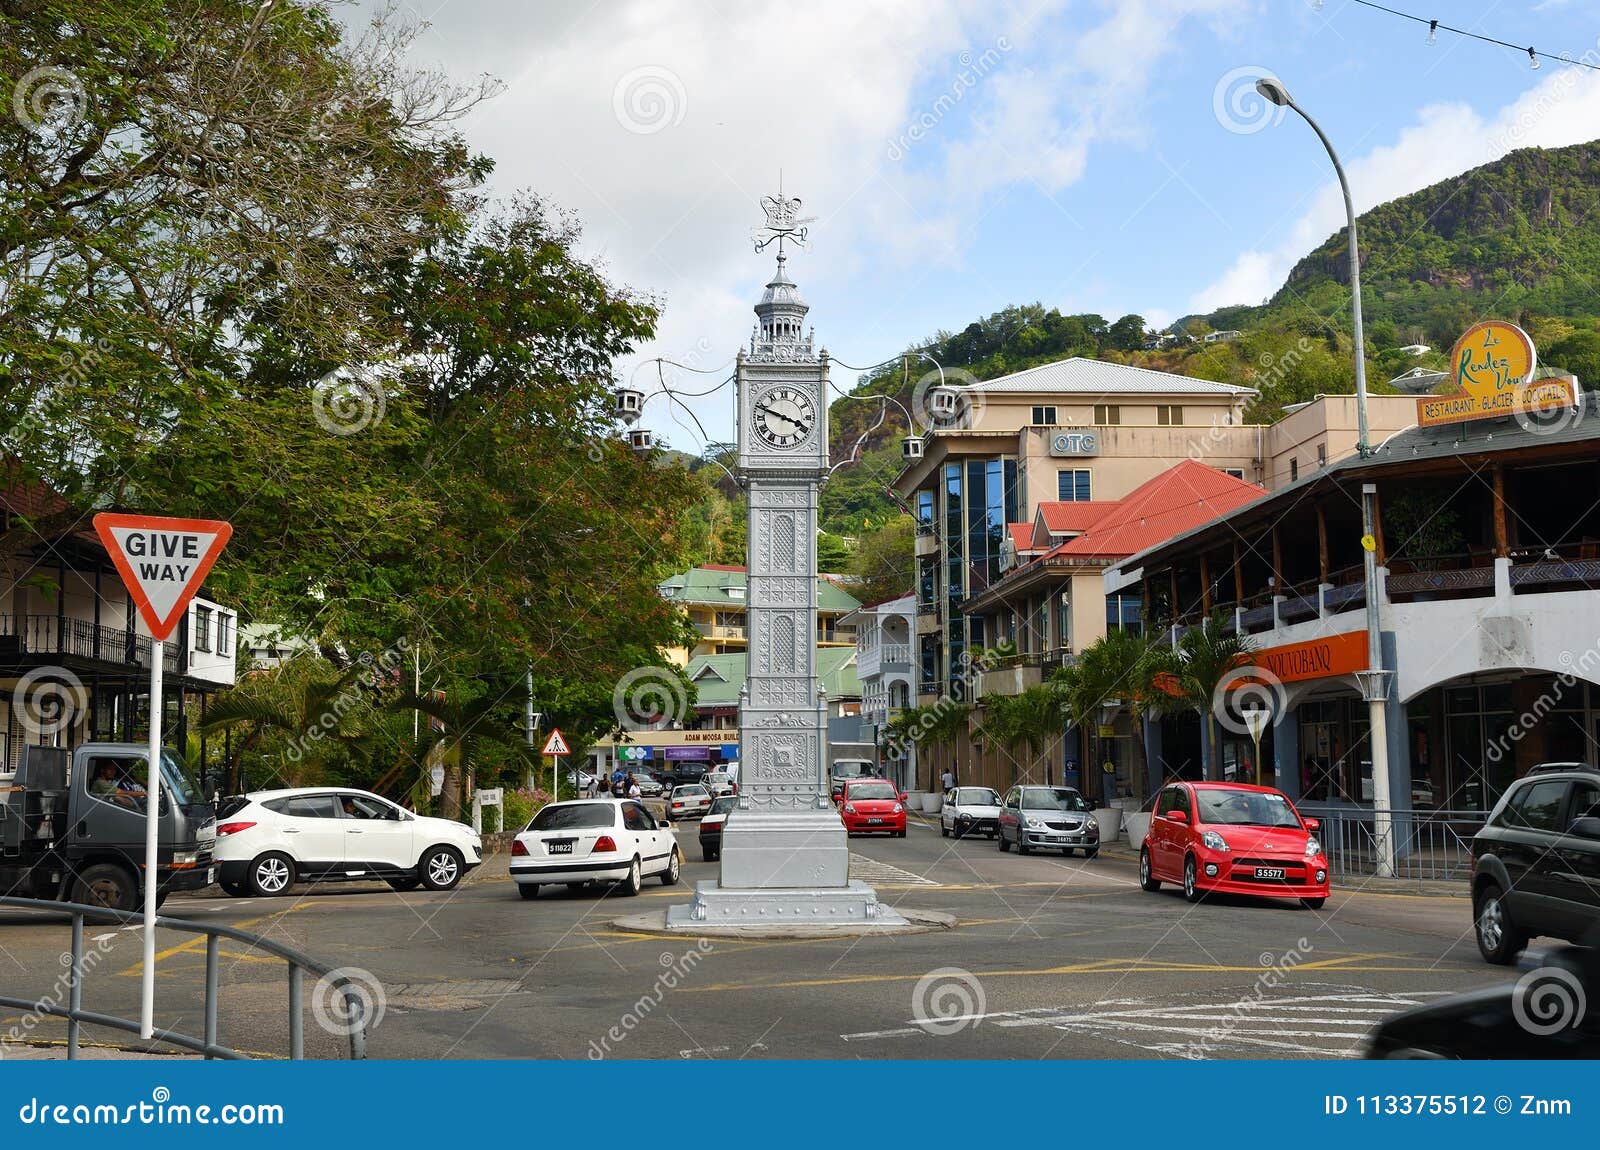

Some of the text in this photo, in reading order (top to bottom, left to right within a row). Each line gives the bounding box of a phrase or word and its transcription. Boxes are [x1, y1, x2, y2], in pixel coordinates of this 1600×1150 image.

[1457, 348, 1511, 385] Rendez
[1425, 398, 1476, 418] RESTAURANT
[1482, 392, 1514, 410] GLACIER
[1522, 385, 1567, 404] COCKTAILS
[1054, 433, 1096, 453] OTC
[125, 532, 199, 559] GIVE
[139, 563, 190, 582] WAY
[1266, 644, 1331, 678] NOUVOBANQ
[685, 733, 700, 741] ADAM
[702, 733, 721, 741] MOOSA
